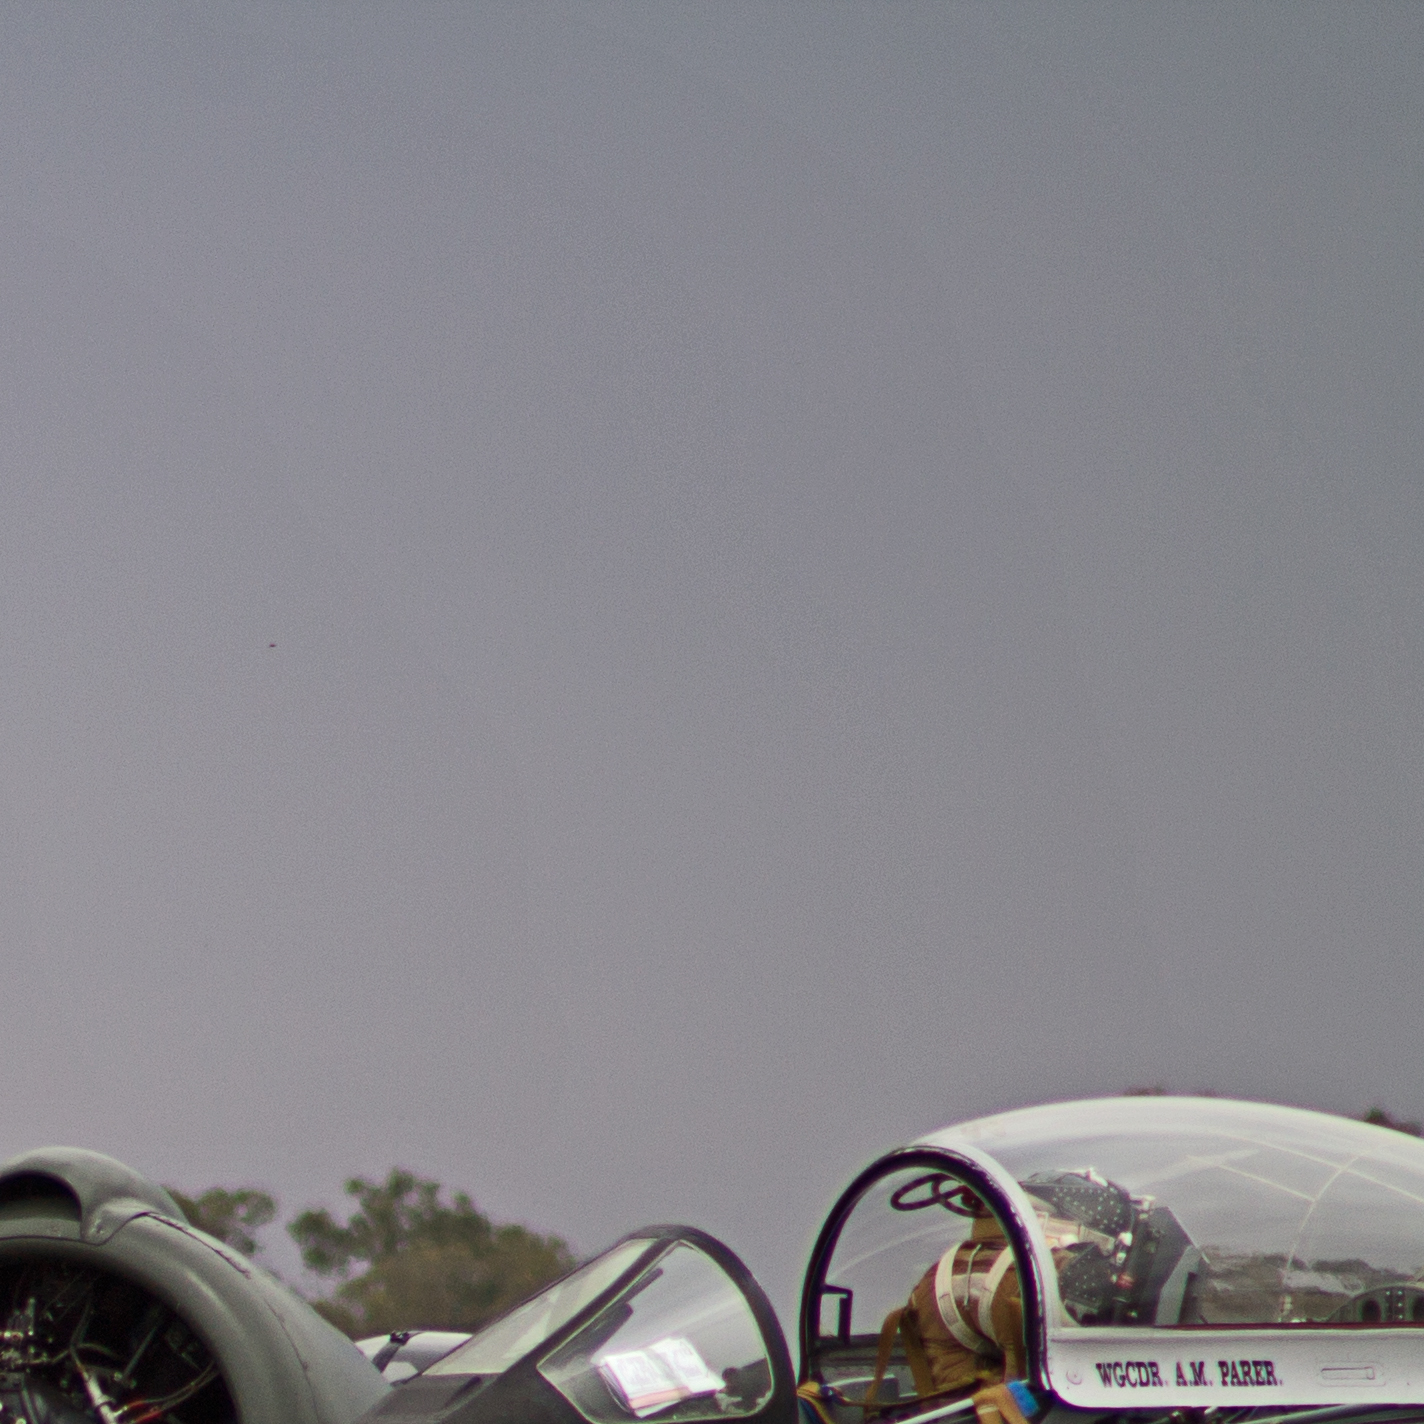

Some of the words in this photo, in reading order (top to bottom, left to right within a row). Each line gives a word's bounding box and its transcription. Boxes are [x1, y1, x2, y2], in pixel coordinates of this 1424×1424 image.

[1095, 1361, 1168, 1389] WGCDR.
[1175, 1361, 1213, 1387] A.M.
[1217, 1360, 1283, 1387] PARER.
